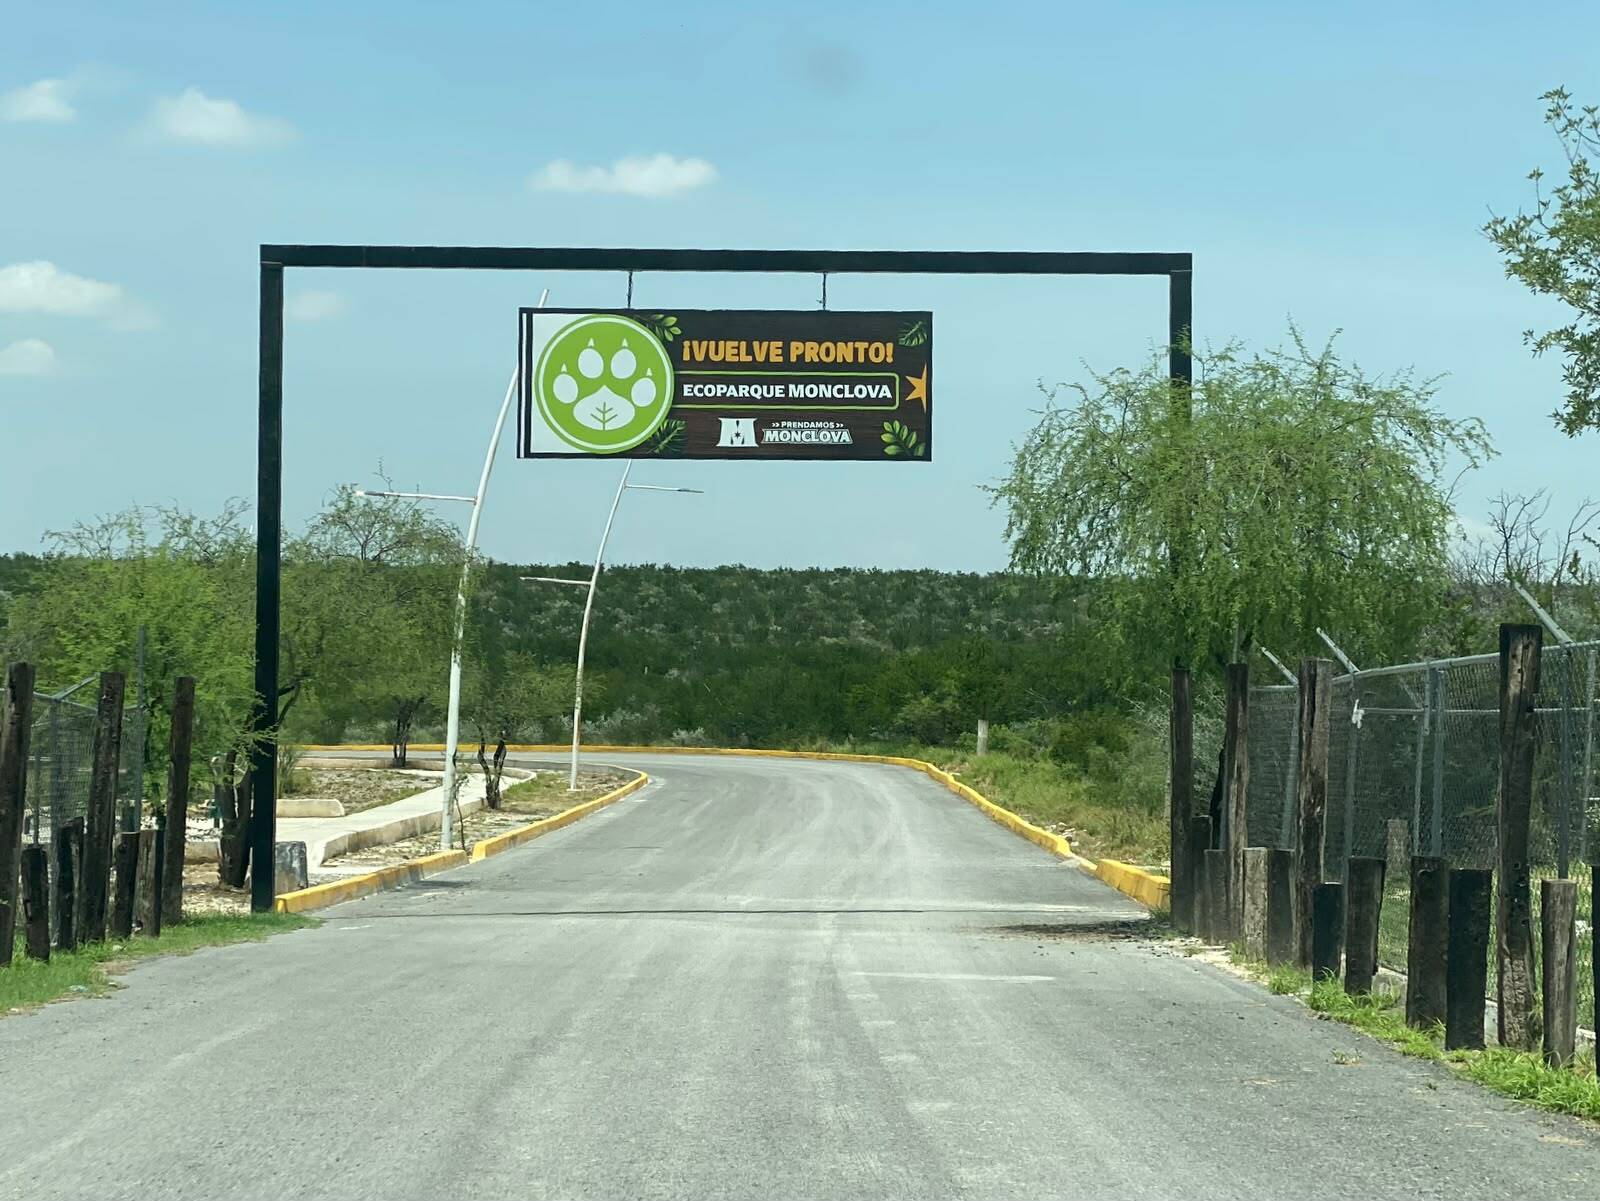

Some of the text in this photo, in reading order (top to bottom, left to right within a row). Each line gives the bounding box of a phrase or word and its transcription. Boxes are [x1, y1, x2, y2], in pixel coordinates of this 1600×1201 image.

[682, 340, 894, 364] ¡VUELVE PRONTO!
[683, 384, 892, 400] ECOPARQUE MONCLOVA
[763, 430, 851, 443] MONCLOVA
